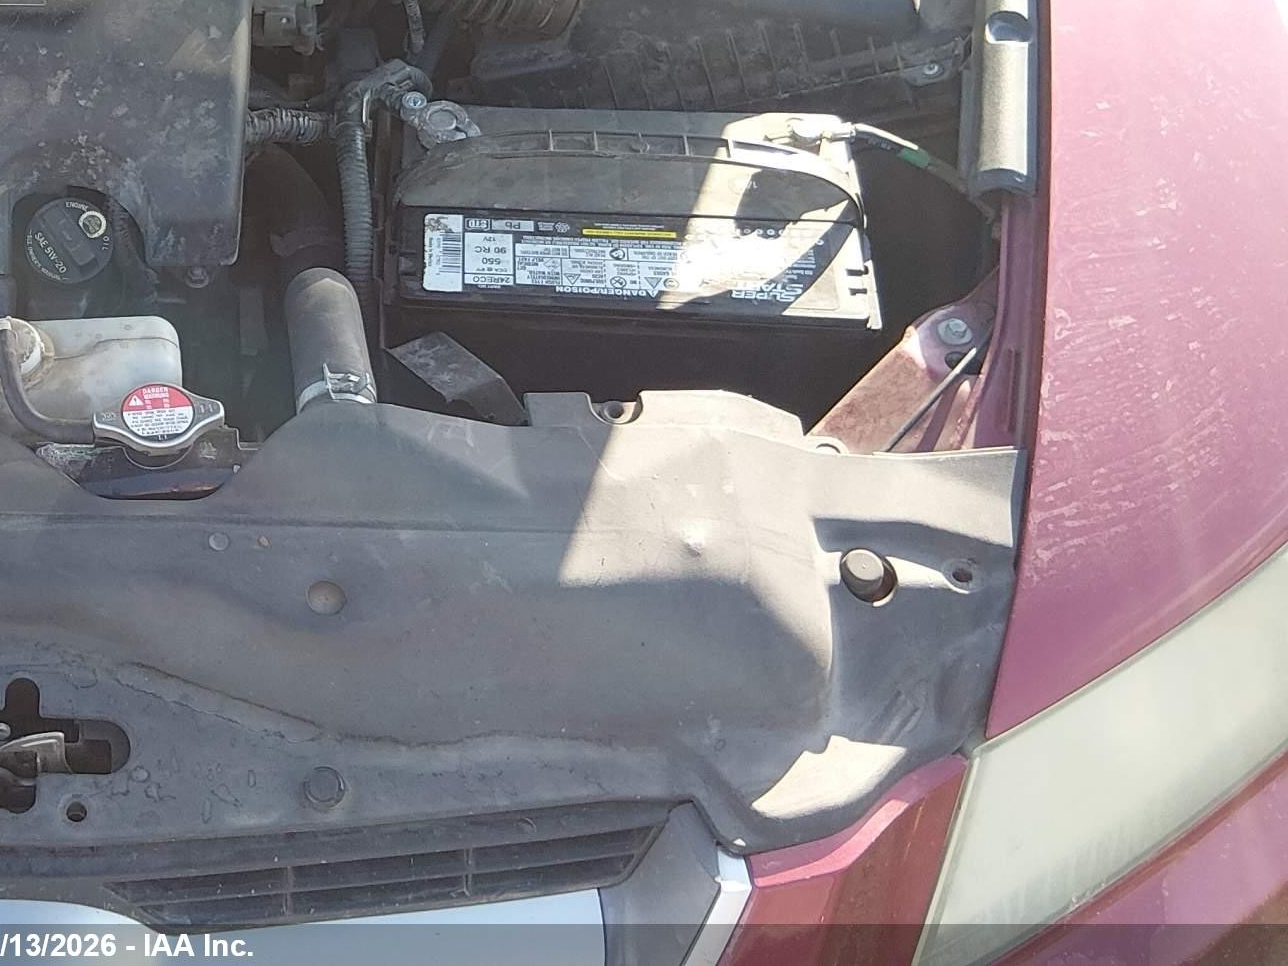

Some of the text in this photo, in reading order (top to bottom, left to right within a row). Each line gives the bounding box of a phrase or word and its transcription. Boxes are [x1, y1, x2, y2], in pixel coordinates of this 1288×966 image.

[505, 221, 521, 229] Pb
[34, 232, 67, 274] SAE 5W-20
[481, 257, 501, 265] 550
[472, 276, 511, 284] 24RECO
[555, 286, 648, 298] DANGER/POISON
[731, 290, 795, 302] SUPER
